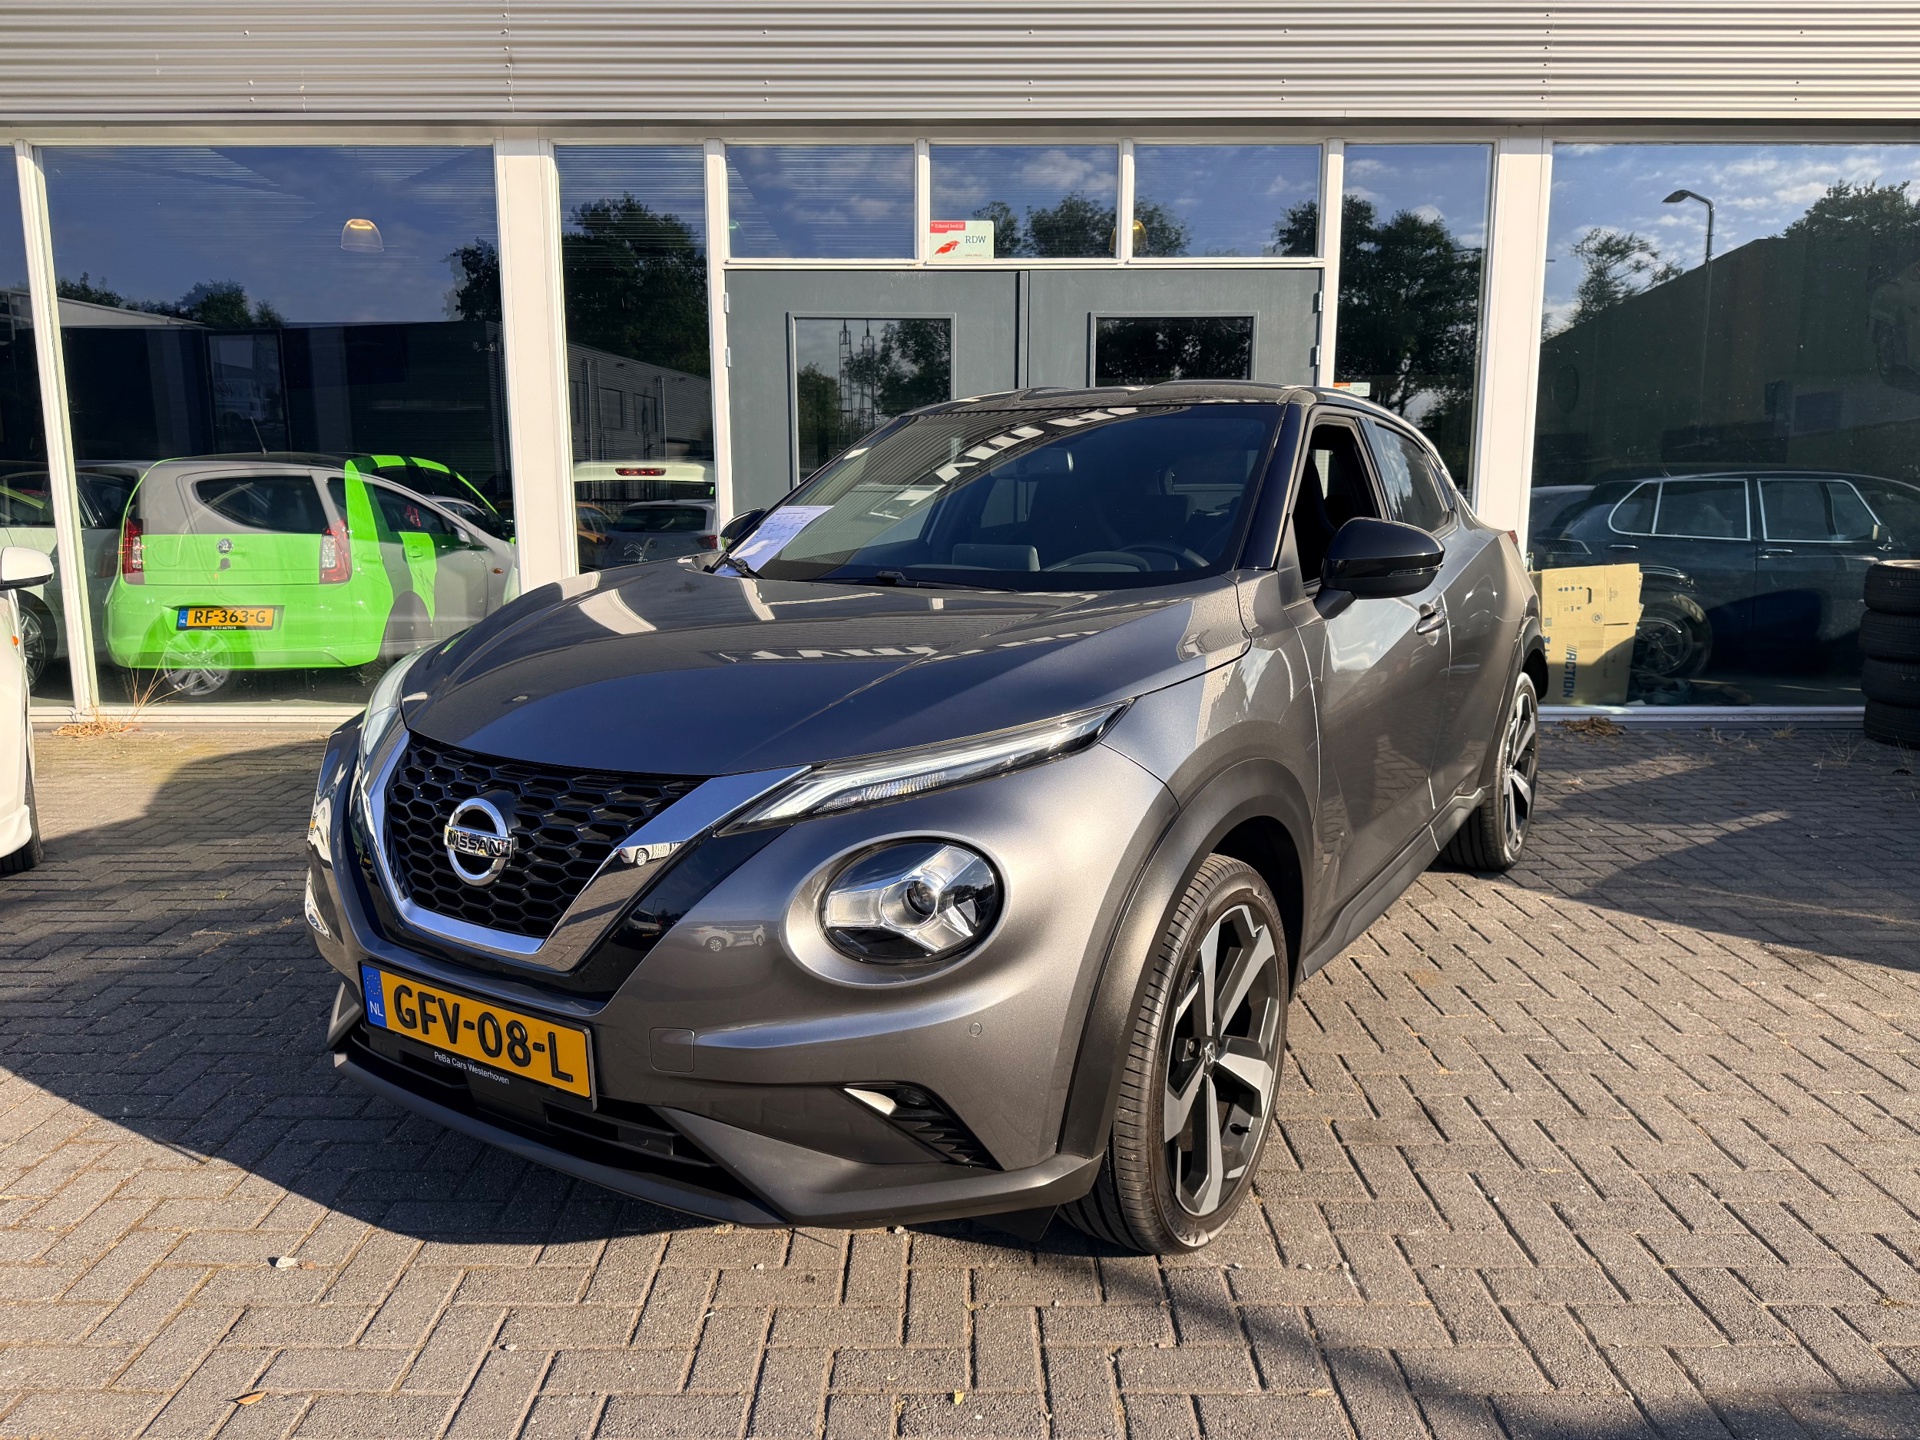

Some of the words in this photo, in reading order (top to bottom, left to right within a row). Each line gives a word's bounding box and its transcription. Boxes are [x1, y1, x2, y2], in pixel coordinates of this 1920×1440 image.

[965, 235, 987, 244] RDW
[193, 610, 266, 624] RF-363-G
[1562, 651, 1577, 698] ACTION
[447, 830, 502, 855] NISSAN
[369, 1000, 384, 1018] NL
[393, 984, 574, 1083] GFV-08-L
[434, 1051, 451, 1064] PeBa
[451, 1057, 467, 1070] Cars
[468, 1063, 510, 1085] Westerhoven
